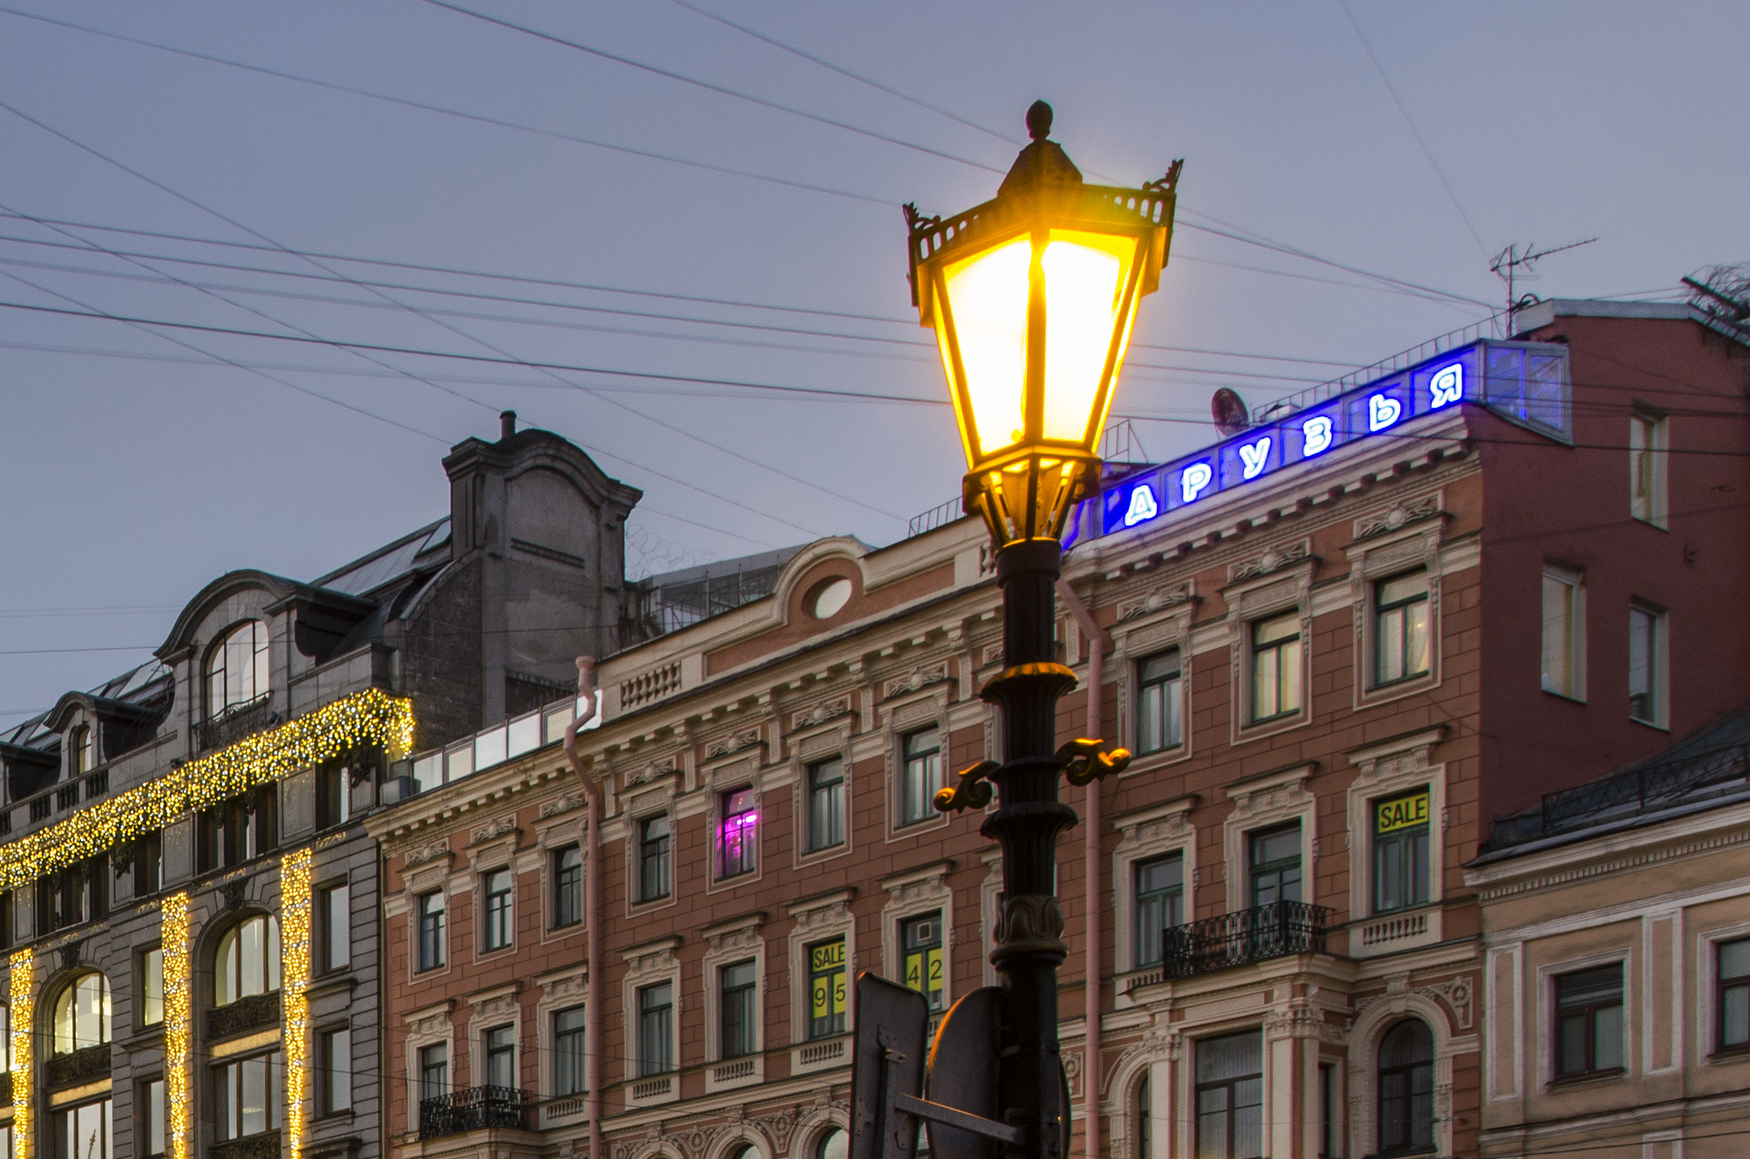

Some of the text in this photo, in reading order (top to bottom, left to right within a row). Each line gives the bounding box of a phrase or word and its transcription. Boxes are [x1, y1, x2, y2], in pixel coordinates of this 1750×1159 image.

[1124, 362, 1463, 527] ДРУЗЬЯ
[1380, 797, 1426, 829] SALE
[814, 943, 845, 969] SALE
